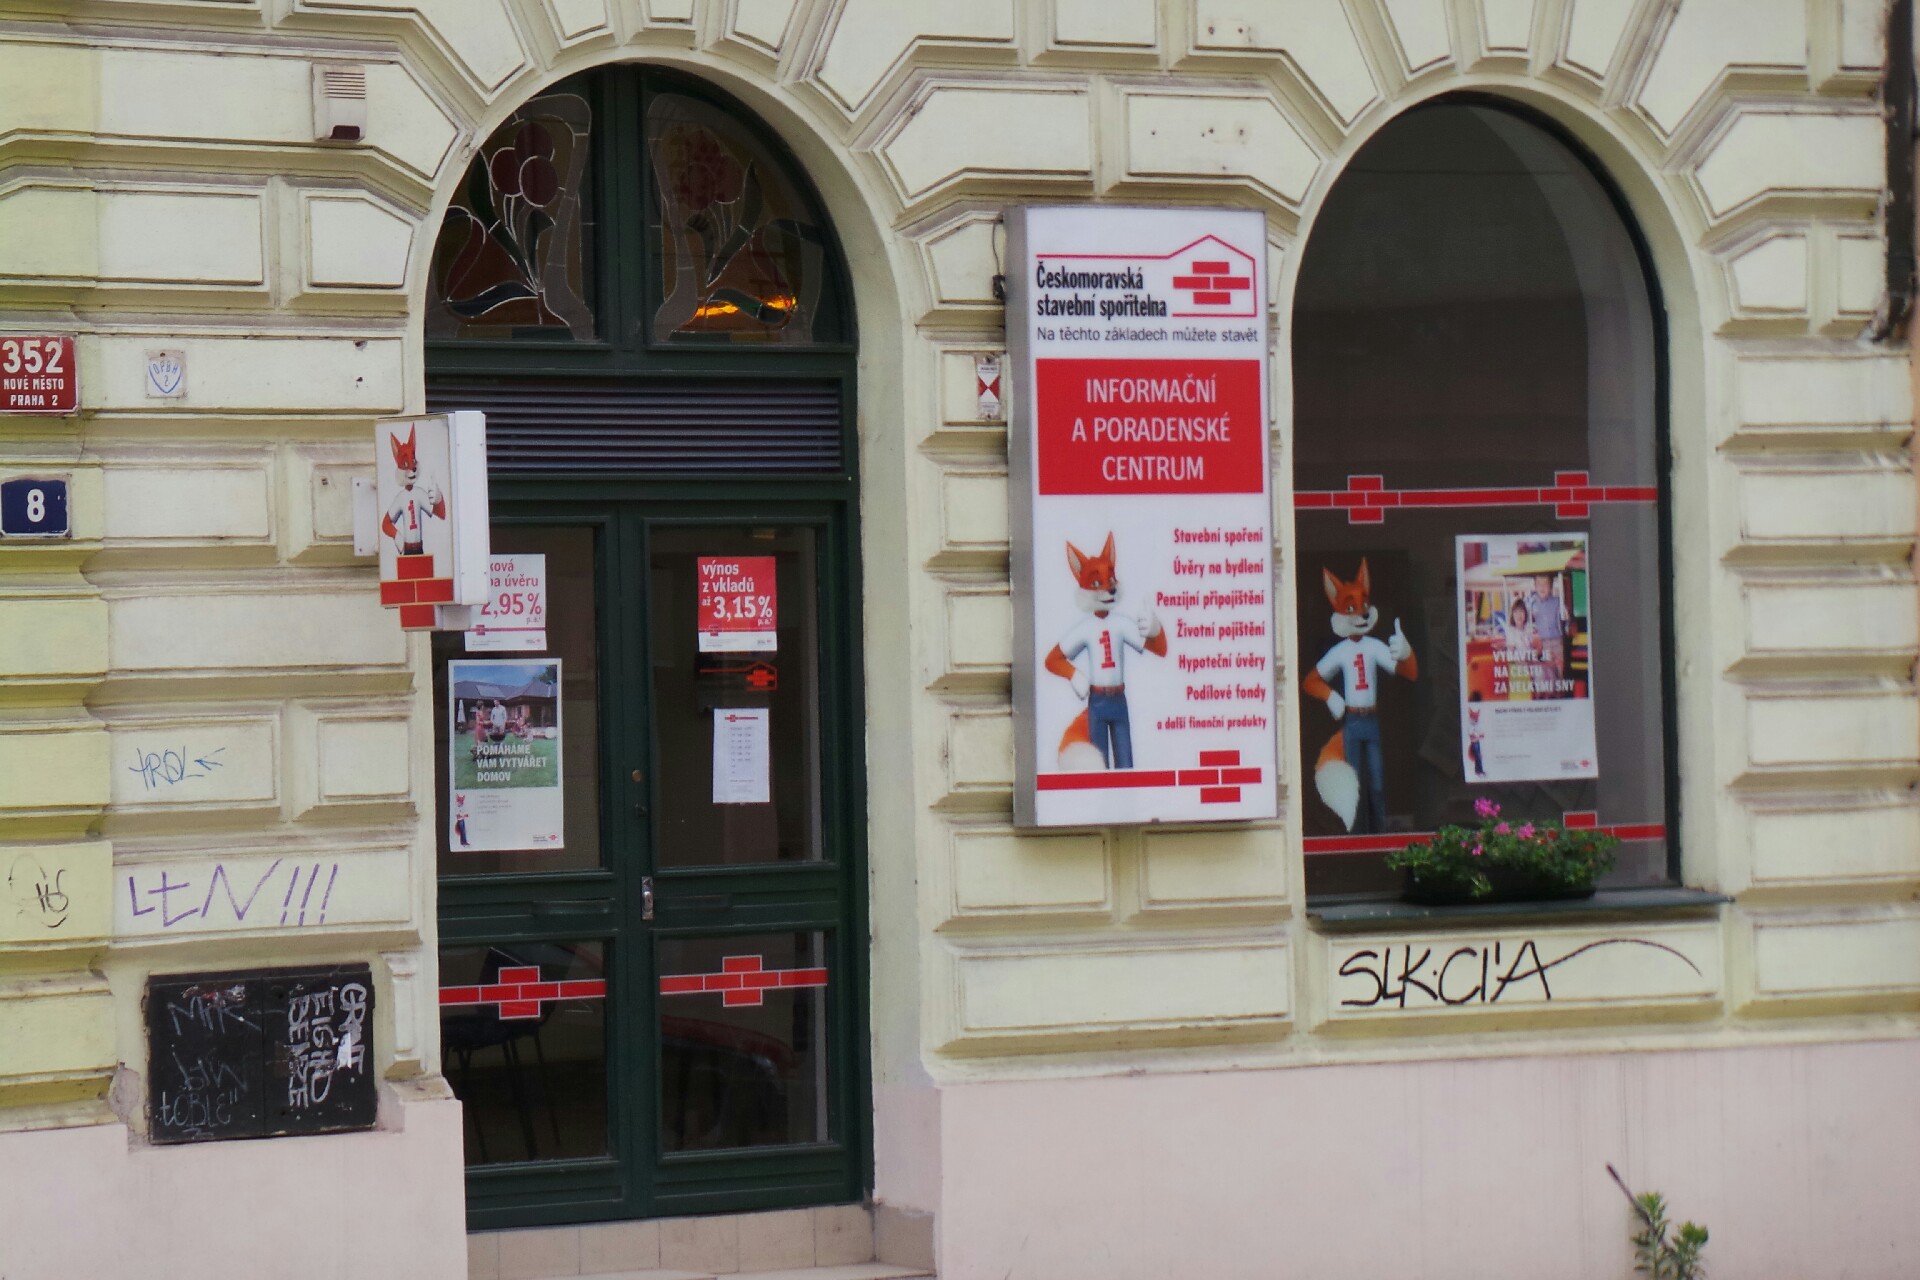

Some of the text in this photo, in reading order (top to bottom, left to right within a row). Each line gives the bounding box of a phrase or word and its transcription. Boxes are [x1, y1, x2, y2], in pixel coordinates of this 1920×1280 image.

[1036, 261, 1143, 289] Českomoravská
[1036, 294, 1167, 321] stavební spořitelna
[1037, 326, 1258, 342] Na těchto základech můžete stavět
[2, 340, 64, 374] 352
[3, 375, 64, 390] NOVÉ MĚSTO
[1086, 373, 1217, 403] INFORMAČNÍ
[10, 394, 59, 406] PRAHA 2
[1071, 411, 1231, 442] A PORADENSKÉ
[1102, 456, 1204, 481] CENTRUM
[27, 489, 45, 522] 8
[1174, 527, 1263, 546] Stavební spoření
[702, 560, 739, 579] výnos
[1173, 555, 1264, 578] Úvěry na bydlení
[504, 573, 538, 587] úvěru
[702, 577, 754, 592] z vkladů
[702, 596, 711, 606] až
[1156, 590, 1264, 610] Penzijní připojištění
[1176, 618, 1265, 641] Životní pojištění
[1099, 630, 1116, 669] 1
[1178, 652, 1266, 672] Hypoteční úvěry
[1494, 665, 1508, 678] NA
[1353, 653, 1369, 691] 1
[1186, 683, 1266, 702] Podílové fondy
[1555, 679, 1575, 691] SNY
[1157, 715, 1267, 731] a další finanční produkty
[477, 756, 498, 768] VÁM
[477, 771, 511, 782] DOMOV
